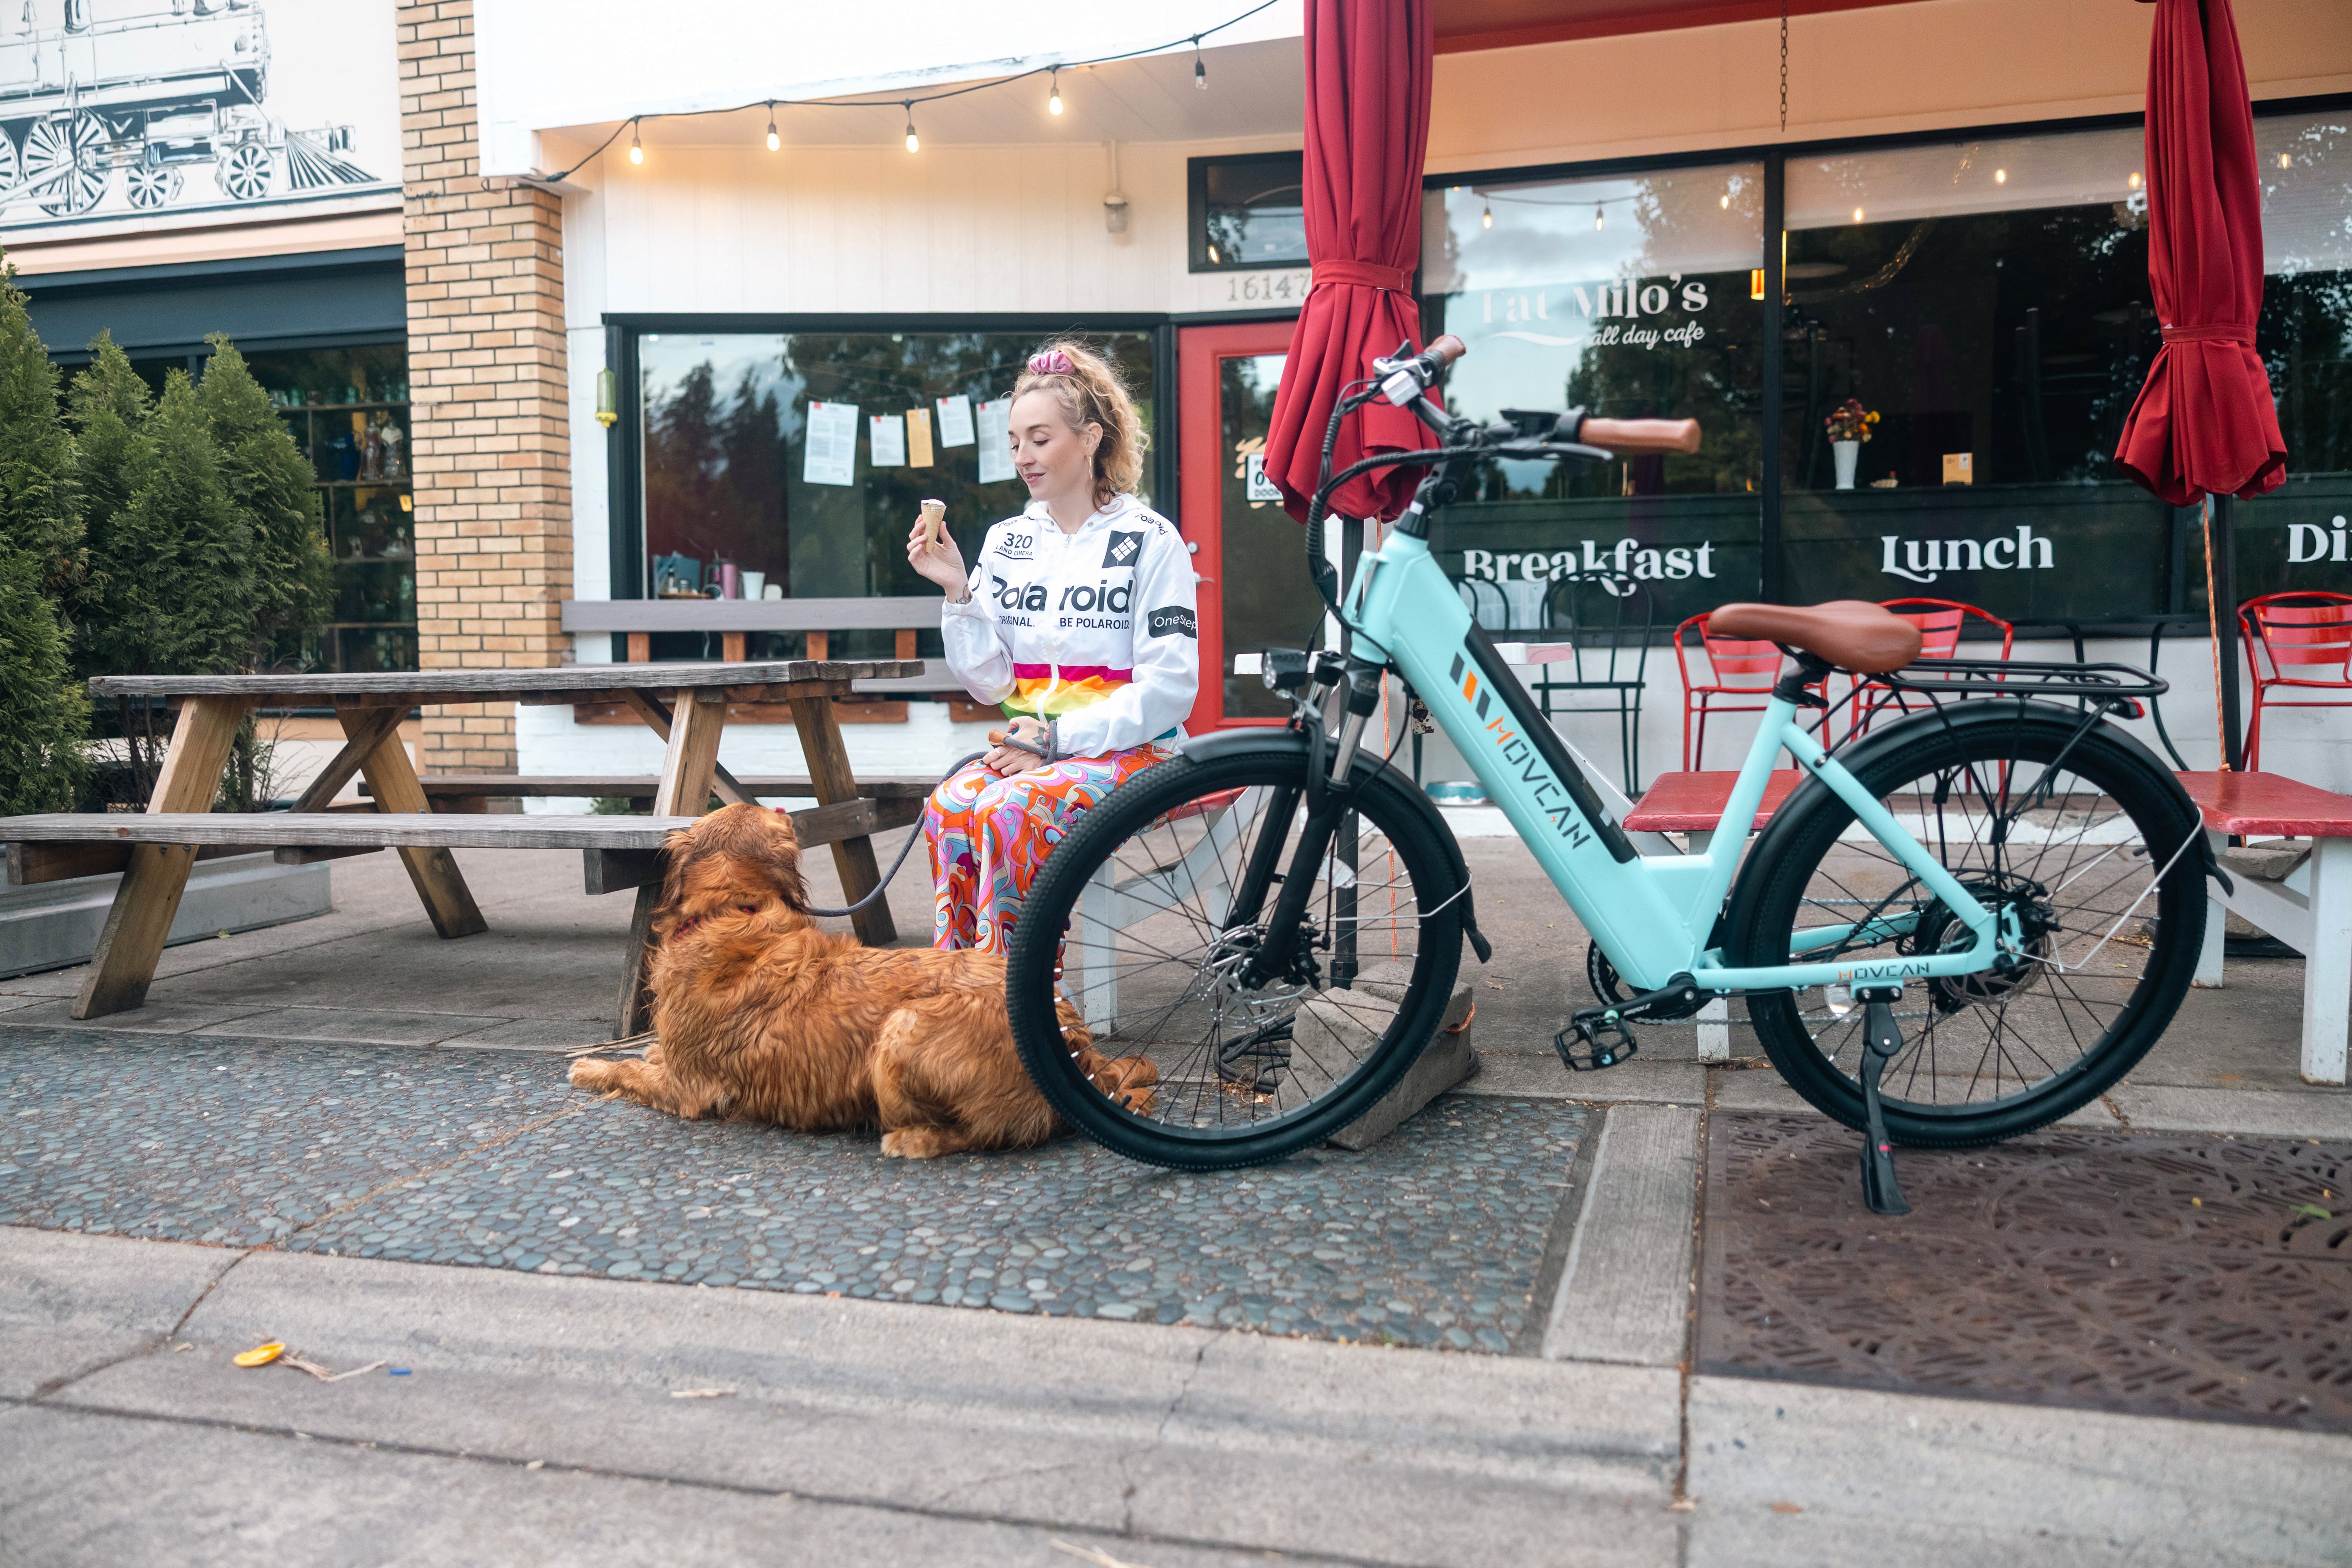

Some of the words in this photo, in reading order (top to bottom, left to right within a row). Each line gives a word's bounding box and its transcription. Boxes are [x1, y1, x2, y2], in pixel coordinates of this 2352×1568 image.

[1227, 273, 1311, 302] 16147
[1572, 272, 1708, 319] Milo's
[1592, 325, 1619, 346] all
[1622, 325, 1661, 350] day
[1664, 320, 1706, 348] cafe
[996, 545, 1012, 555] LAND
[1004, 533, 1033, 548] 320
[2287, 515, 2352, 563] Di
[1463, 538, 1716, 597] Breakfast
[1881, 525, 2055, 583] Lunch
[1060, 618, 1073, 627] BE
[1076, 618, 1129, 629] POLAROID.
[1154, 615, 1196, 630] OneStep
